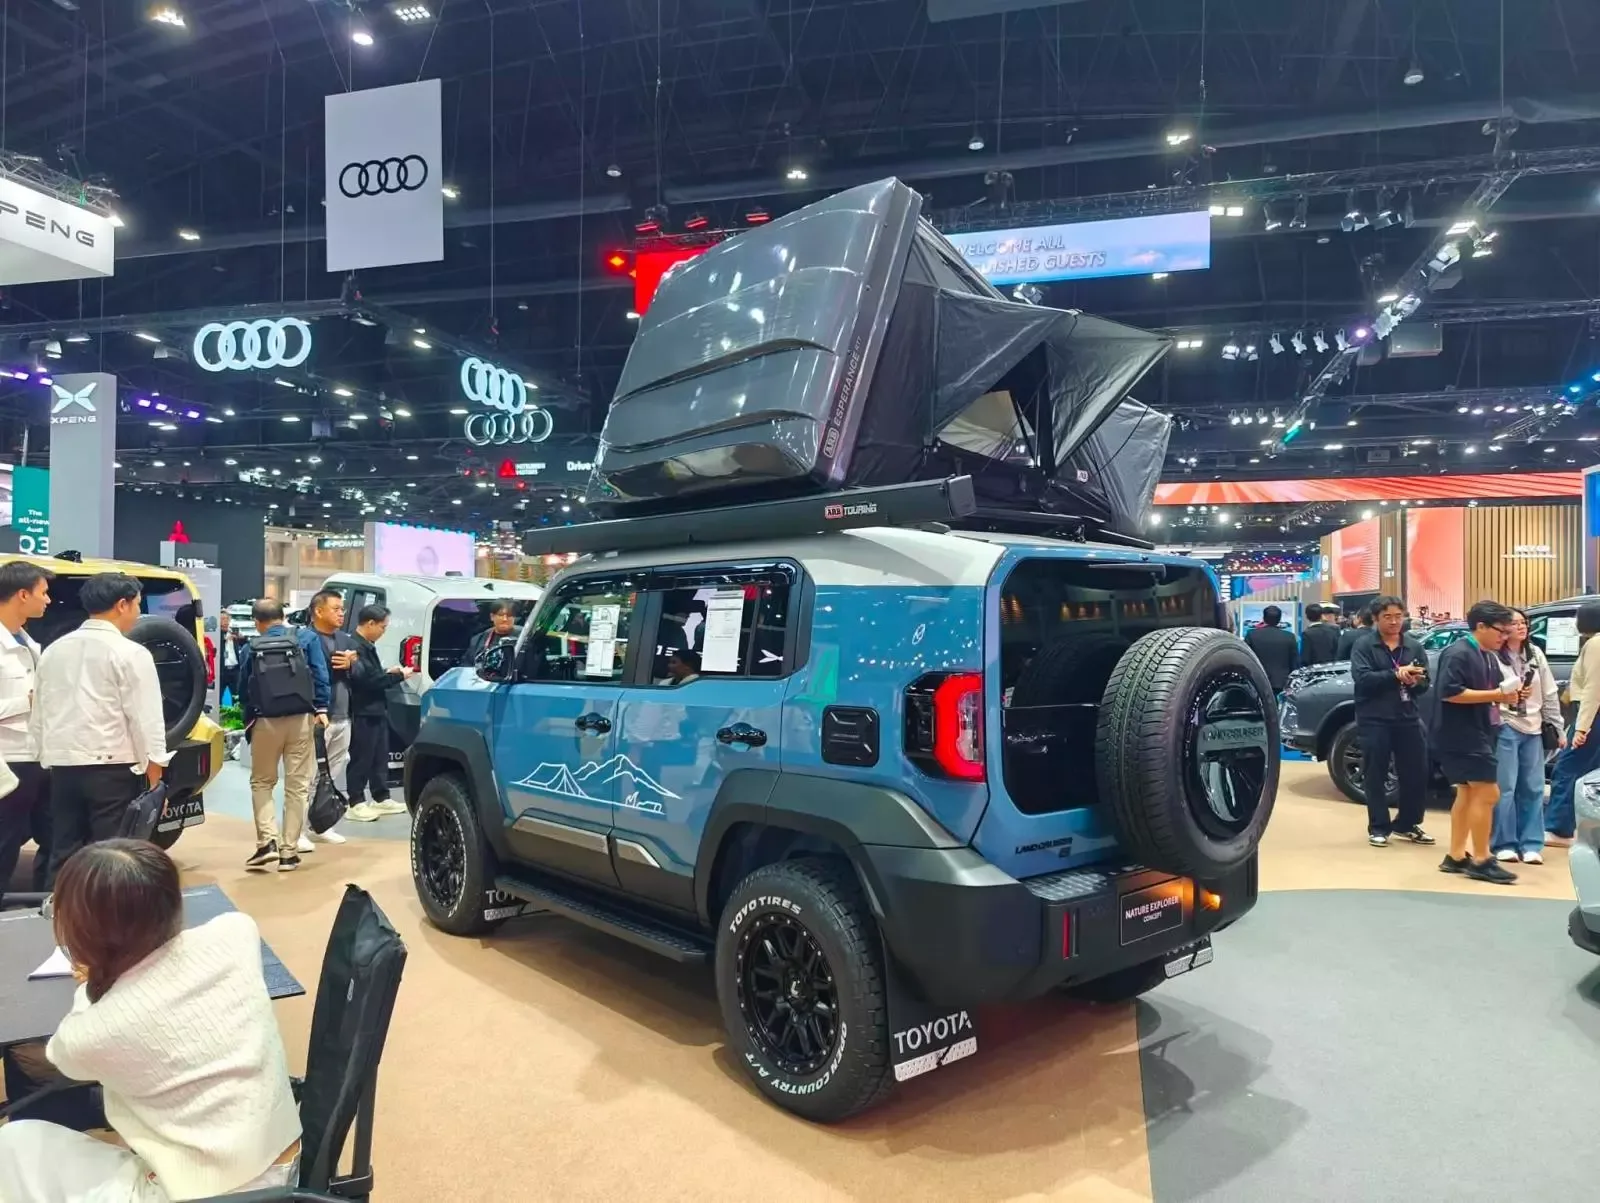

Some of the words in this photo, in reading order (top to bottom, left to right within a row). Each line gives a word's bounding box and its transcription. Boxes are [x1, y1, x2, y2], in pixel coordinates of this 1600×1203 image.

[1034, 235, 1065, 250] ALL
[1043, 251, 1107, 270] GUESTS
[834, 352, 860, 426] ESPERANCE
[50, 415, 97, 424] XPENG
[825, 504, 843, 519] ARB
[843, 503, 877, 516] TOURING
[19, 535, 49, 555] Q3
[1220, 574, 1231, 603] MINI
[729, 899, 757, 934] TOYO
[758, 896, 801, 915] TIRES
[1125, 904, 1149, 919] NATURE
[1150, 896, 1179, 912] EXPLORER
[1143, 911, 1162, 922] CONCEPT
[893, 1010, 972, 1054] TOYOTA
[830, 1021, 847, 1075] OPEN
[745, 1052, 771, 1078] A/T
[770, 1071, 830, 1094] COUNTRY
